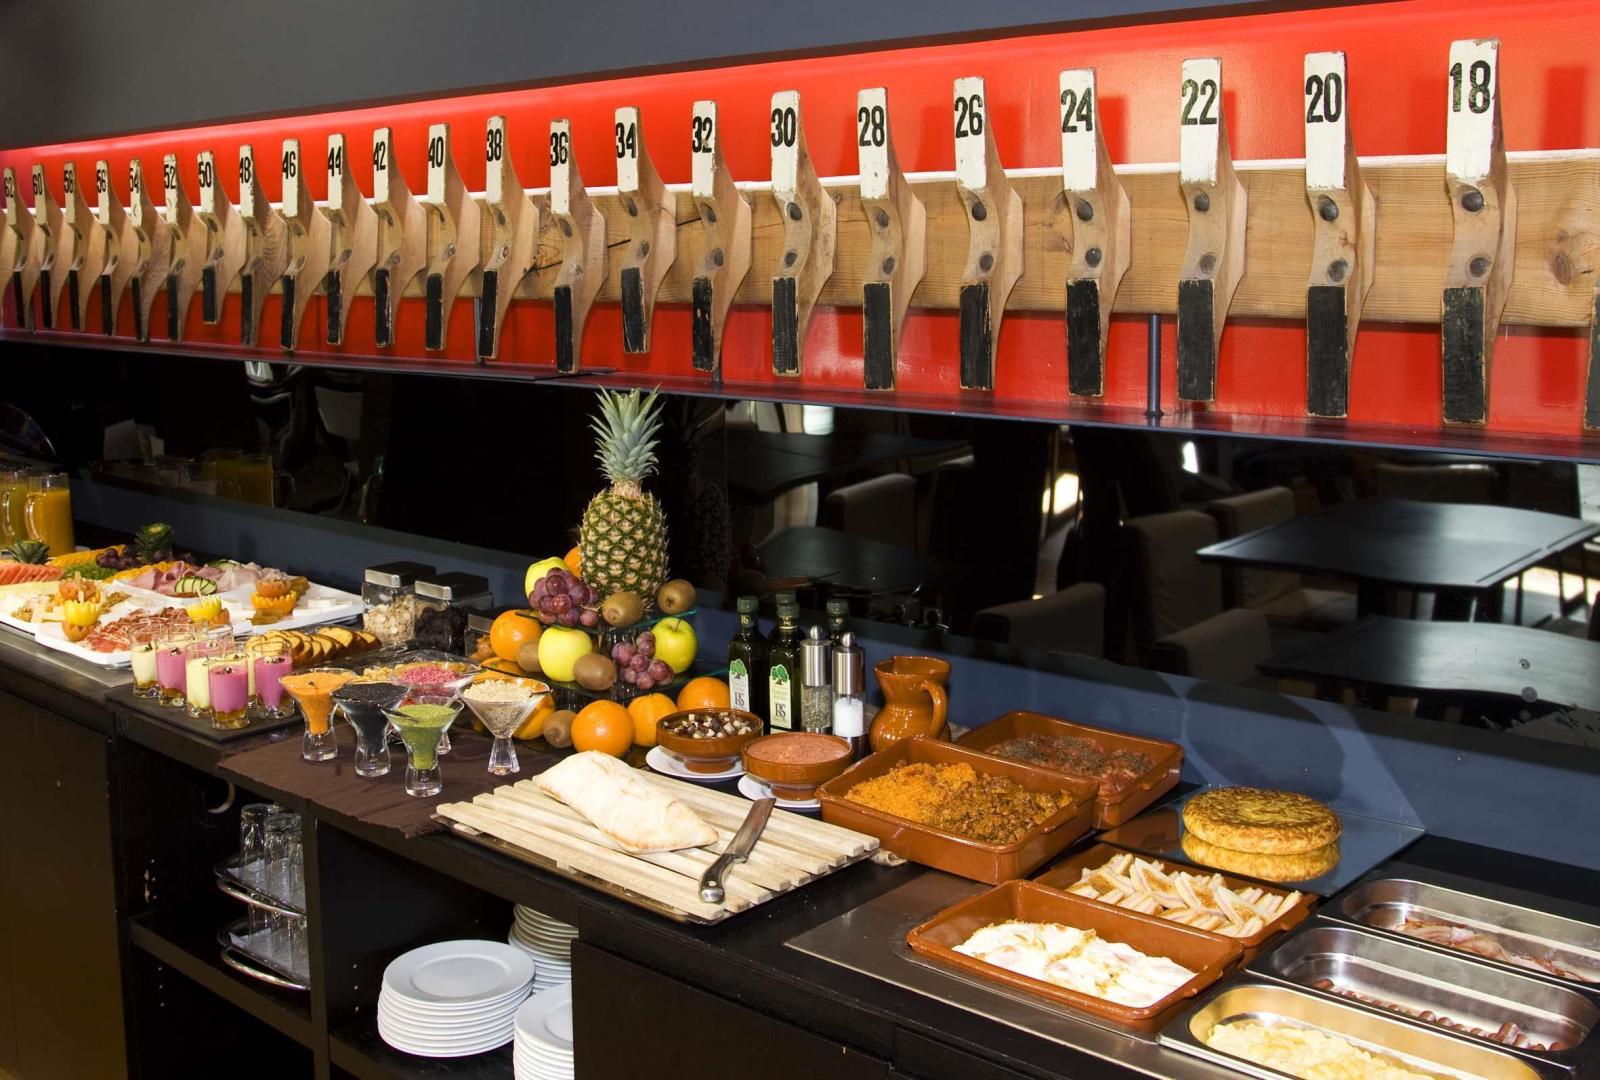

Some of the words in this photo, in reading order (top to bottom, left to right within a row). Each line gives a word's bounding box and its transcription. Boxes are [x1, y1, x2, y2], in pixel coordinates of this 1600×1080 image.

[1181, 79, 1218, 125] 22
[1306, 72, 1342, 123] 20
[1449, 60, 1492, 114] 18
[770, 106, 796, 148] 30
[857, 105, 885, 147] 28
[954, 94, 983, 138] 26
[1060, 88, 1093, 133] 24
[486, 128, 502, 162] 38
[550, 131, 568, 167] 36
[615, 121, 637, 159] 34
[692, 115, 713, 153] 32
[282, 150, 296, 179] 46
[328, 145, 342, 177] 44
[373, 139, 387, 172] 42
[428, 136, 444, 169] 40
[32, 172, 43, 195] 60
[96, 169, 106, 193] 56
[129, 167, 139, 194] 54
[164, 164, 176, 190] 52
[198, 161, 212, 188] 50
[239, 156, 251, 183] 48
[4, 176, 13, 198] 62
